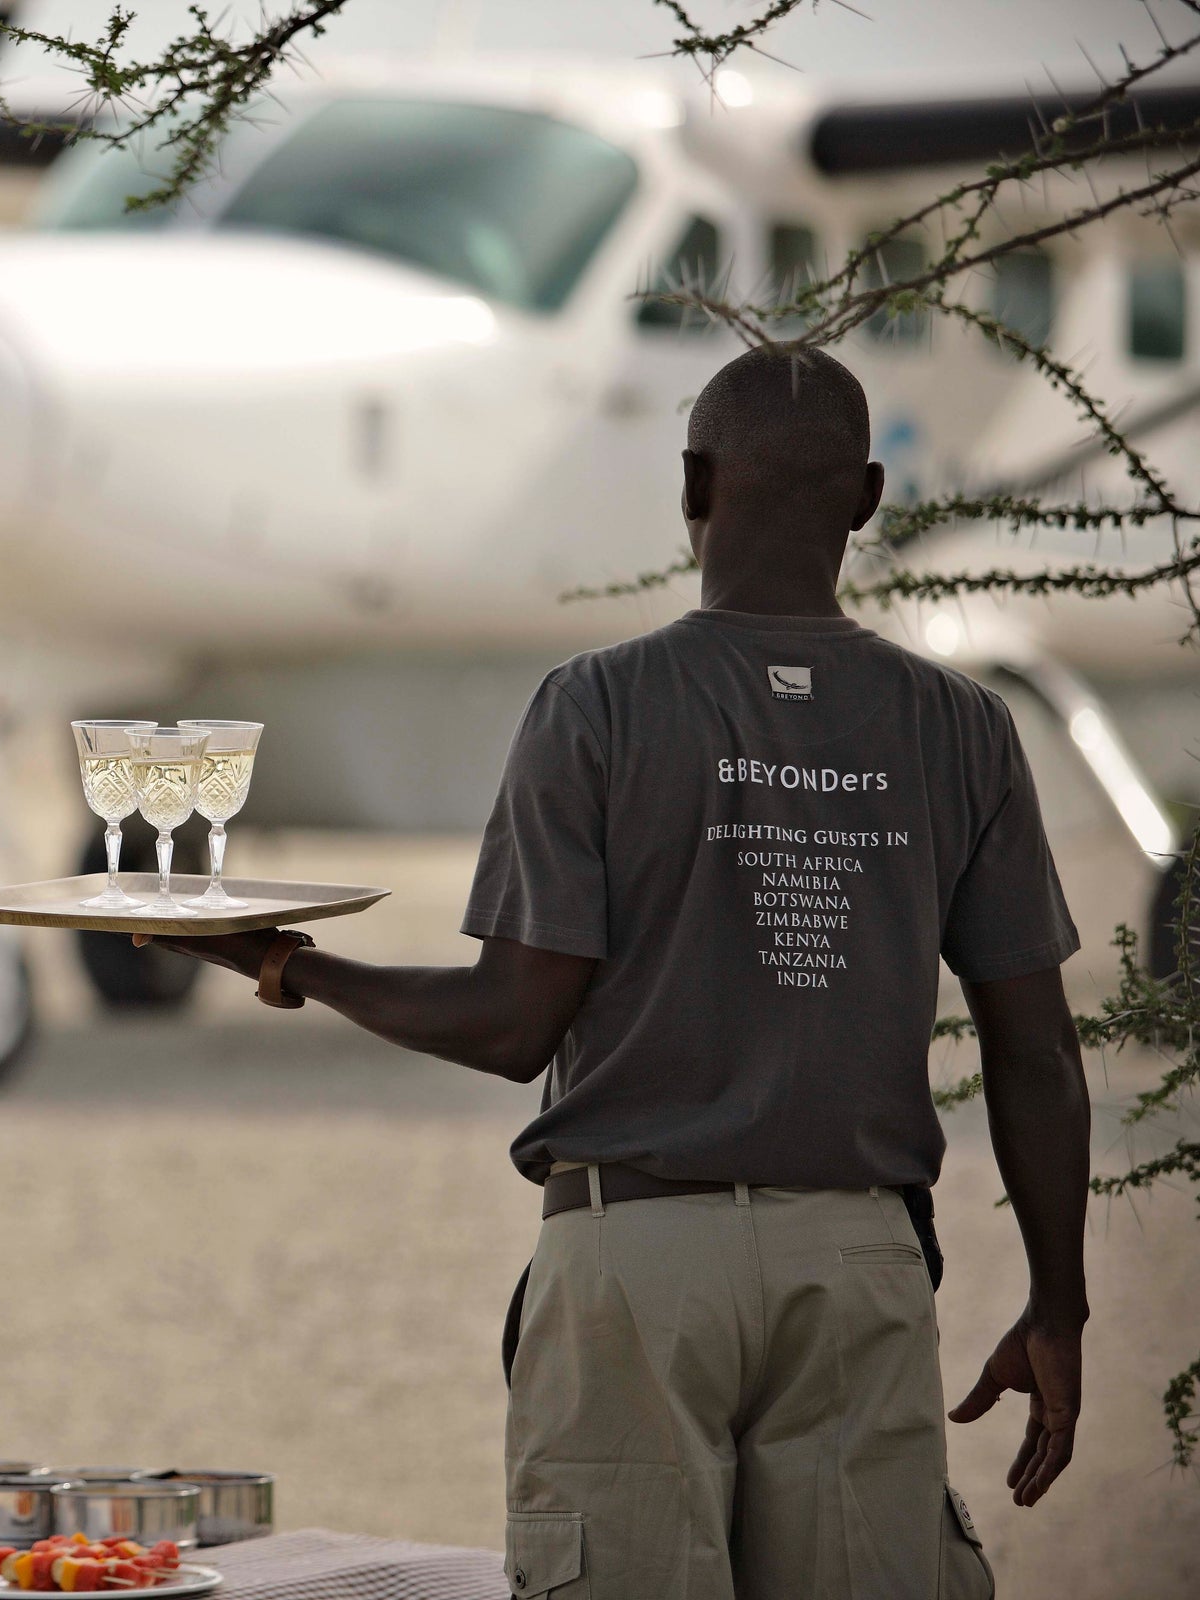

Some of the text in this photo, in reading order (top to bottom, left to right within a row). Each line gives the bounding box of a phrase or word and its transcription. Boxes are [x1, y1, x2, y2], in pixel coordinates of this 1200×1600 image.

[718, 758, 888, 792] &BEYONDers
[707, 825, 909, 847] DELIGHTING GUESTS IN
[737, 852, 864, 873] SOUTH AFRICA
[762, 873, 841, 890] NAMIBIA
[754, 892, 851, 910] BOTSWANA
[755, 911, 849, 930] ZIMBABWE
[774, 932, 831, 949] KENYA
[757, 950, 848, 969] TANZANIA
[777, 970, 829, 988] INDIA
